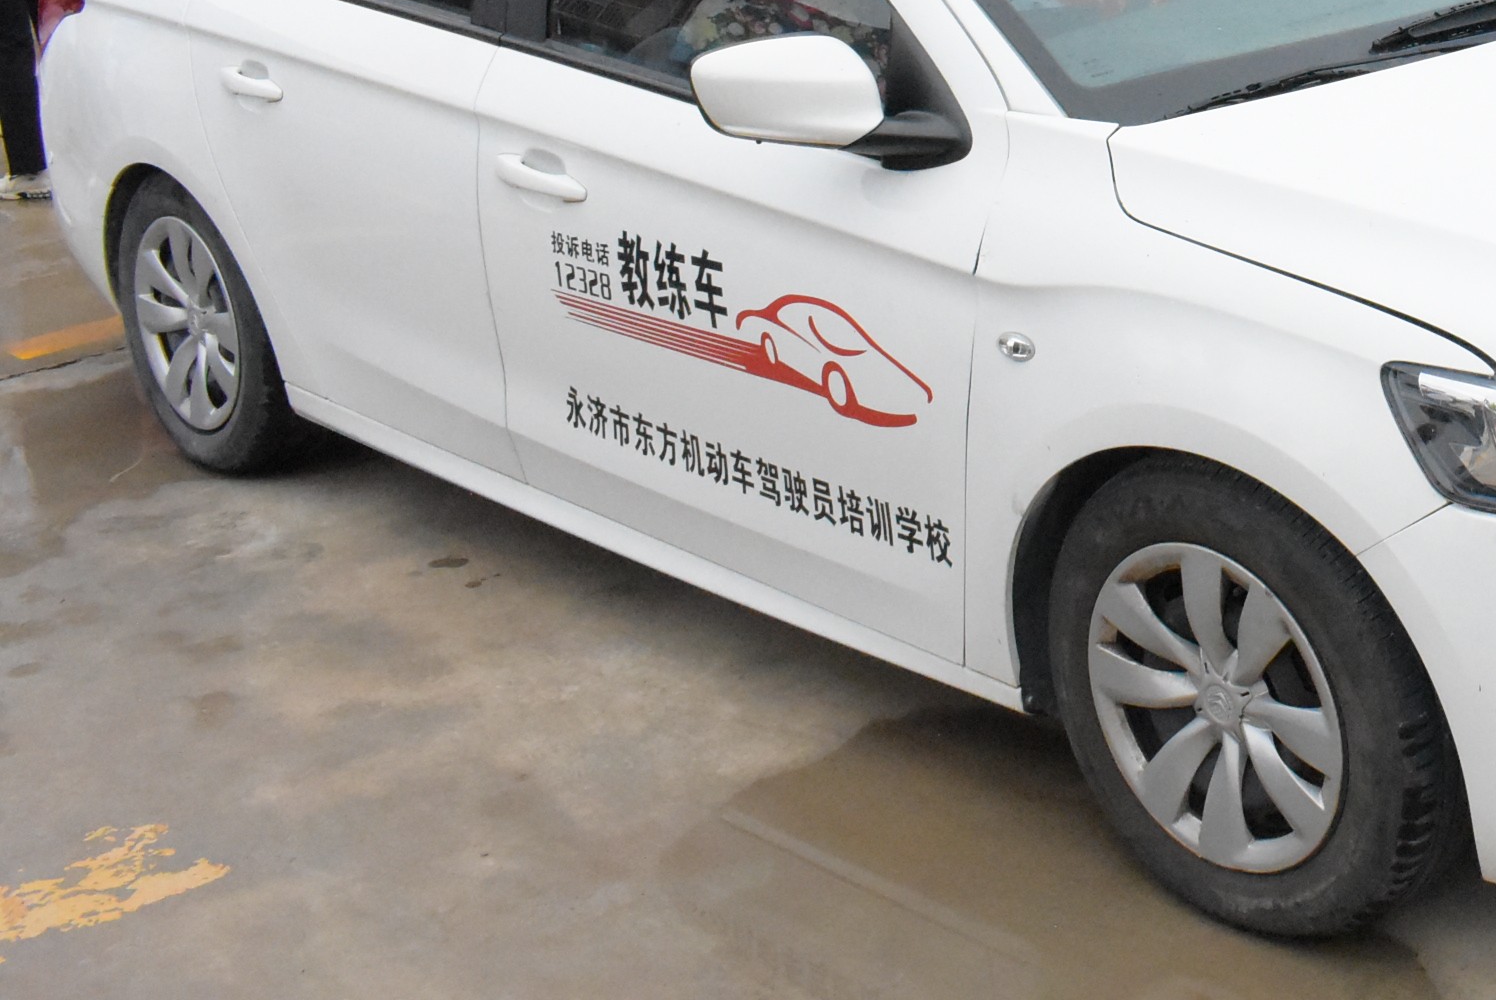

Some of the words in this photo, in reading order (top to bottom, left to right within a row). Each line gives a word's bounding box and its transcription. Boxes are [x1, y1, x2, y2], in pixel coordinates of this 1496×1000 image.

[551, 230, 610, 267] 投诉电话
[555, 261, 612, 300] 12328
[617, 230, 728, 329] 教练车
[566, 385, 953, 568] 永济市东方机动车驾驶员培训学校
